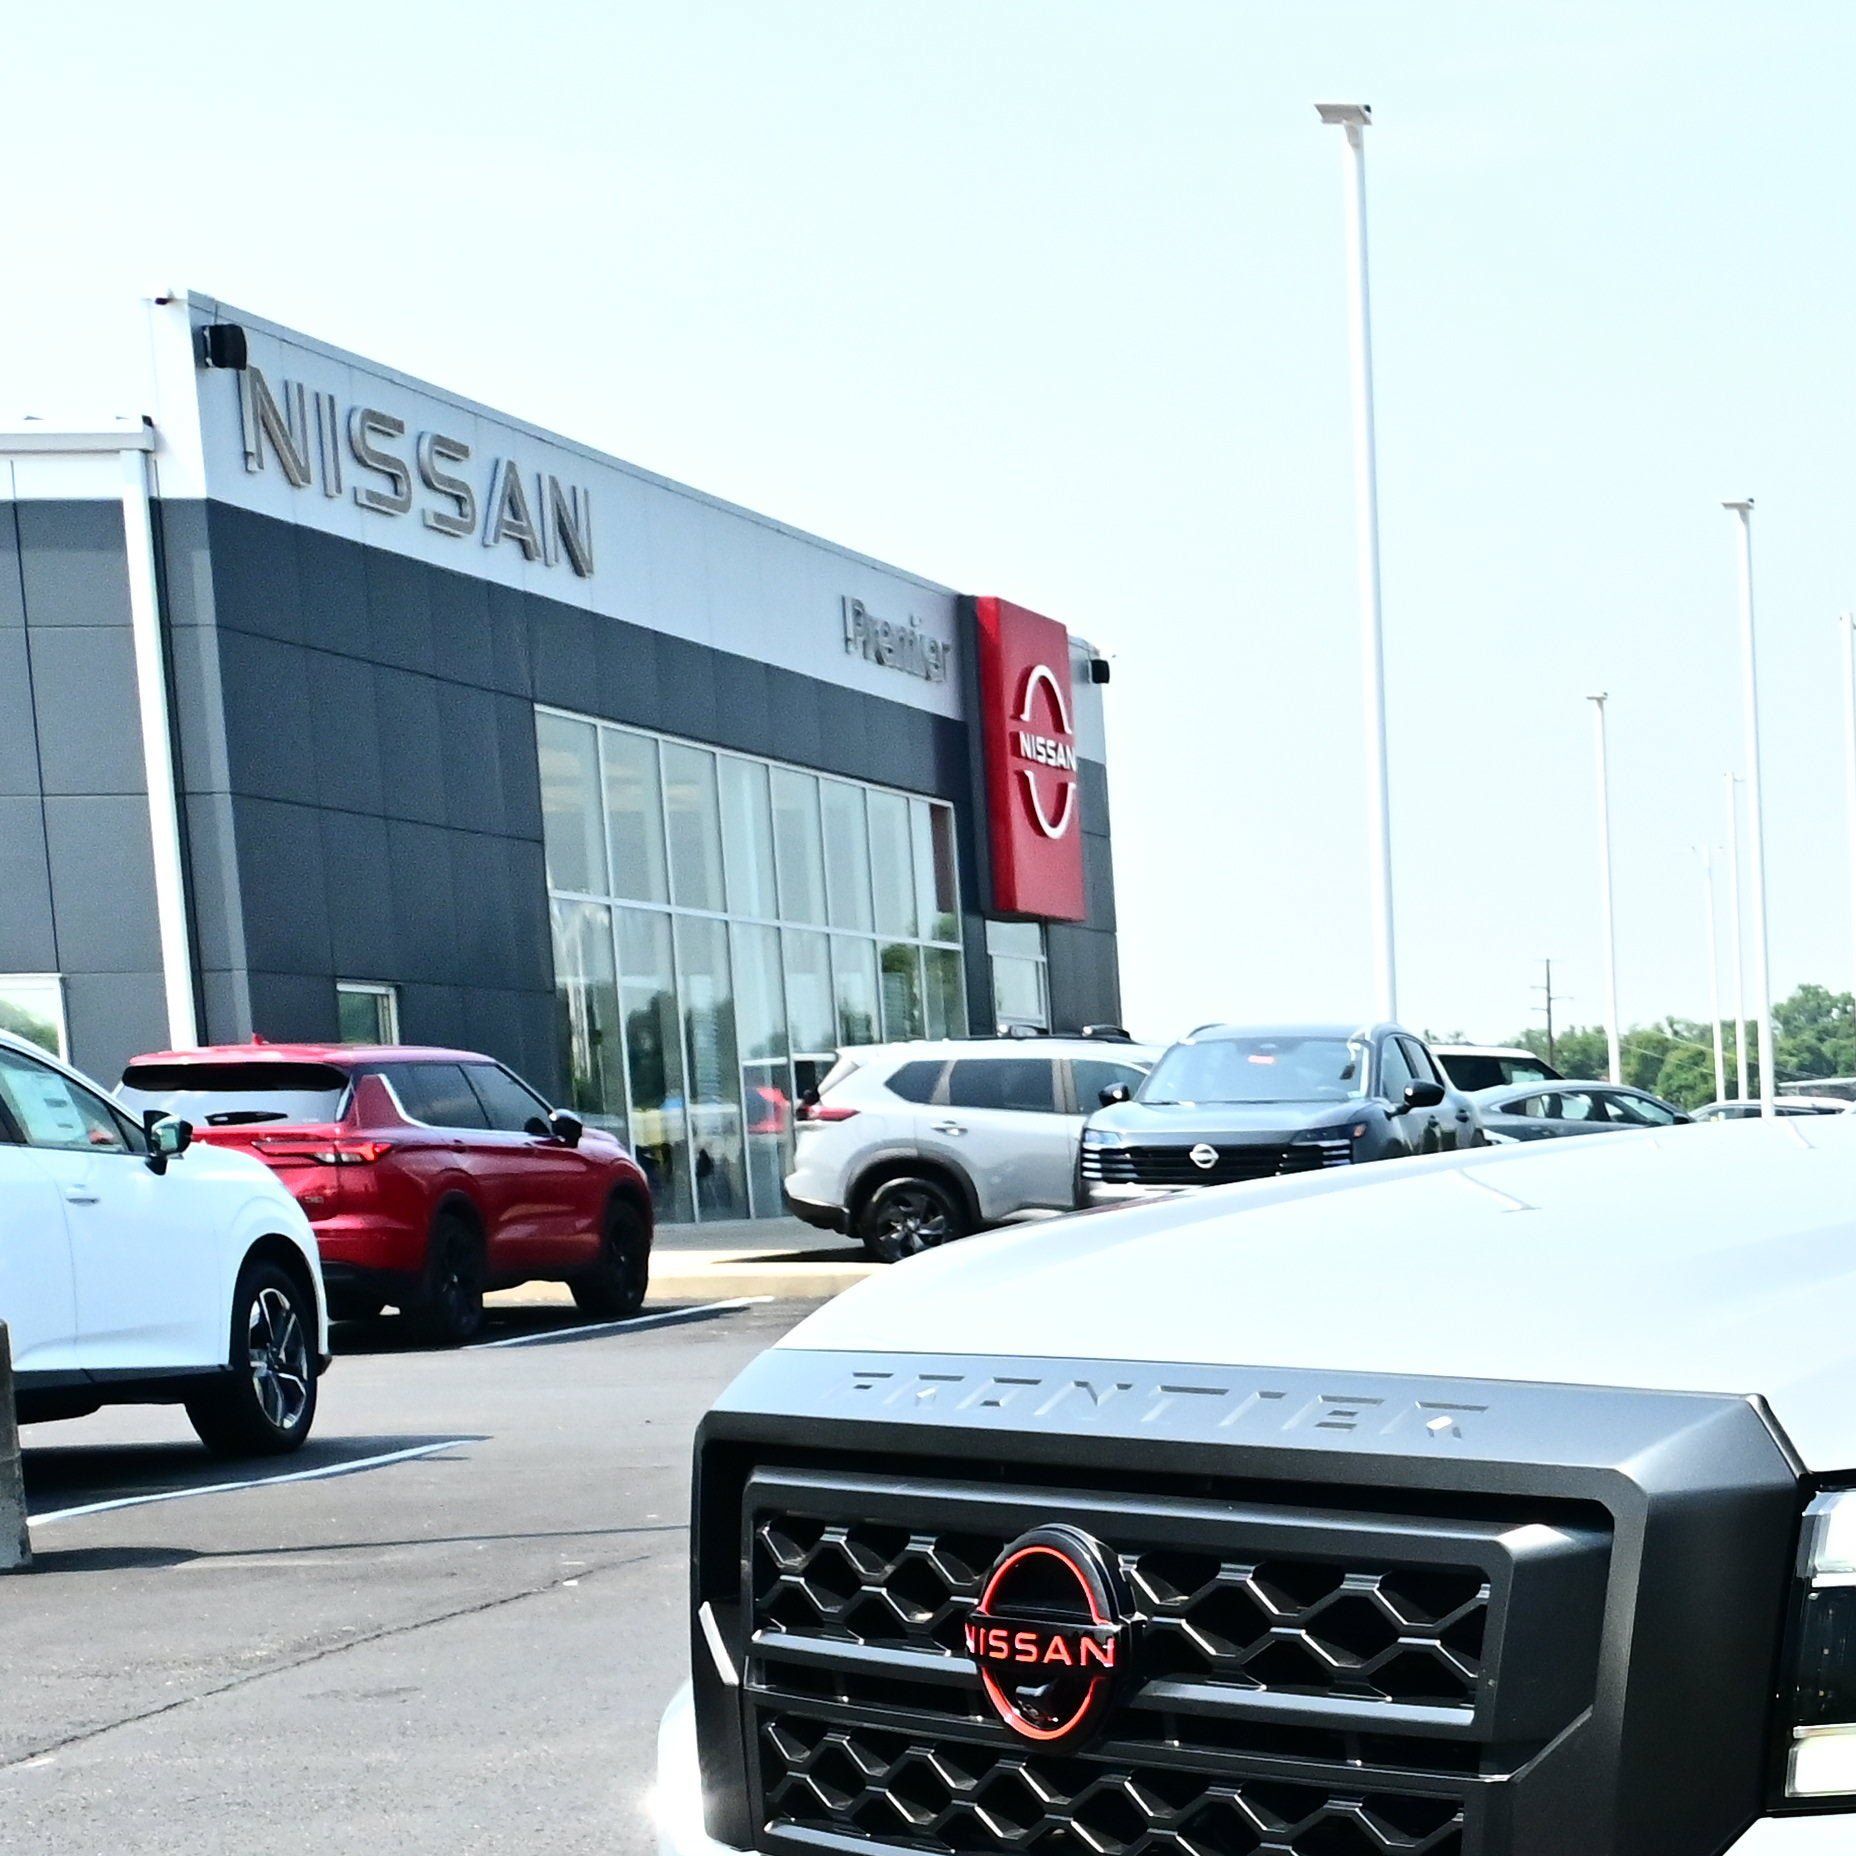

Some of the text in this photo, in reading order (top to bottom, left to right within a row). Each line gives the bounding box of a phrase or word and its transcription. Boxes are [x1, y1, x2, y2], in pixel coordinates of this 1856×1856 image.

[238, 362, 595, 578] NISSAN
[841, 595, 951, 682] Premier
[1019, 730, 1078, 771] NISSAN
[824, 1371, 1490, 1440] FRONTIER
[964, 1622, 1116, 1669] NISSAN
